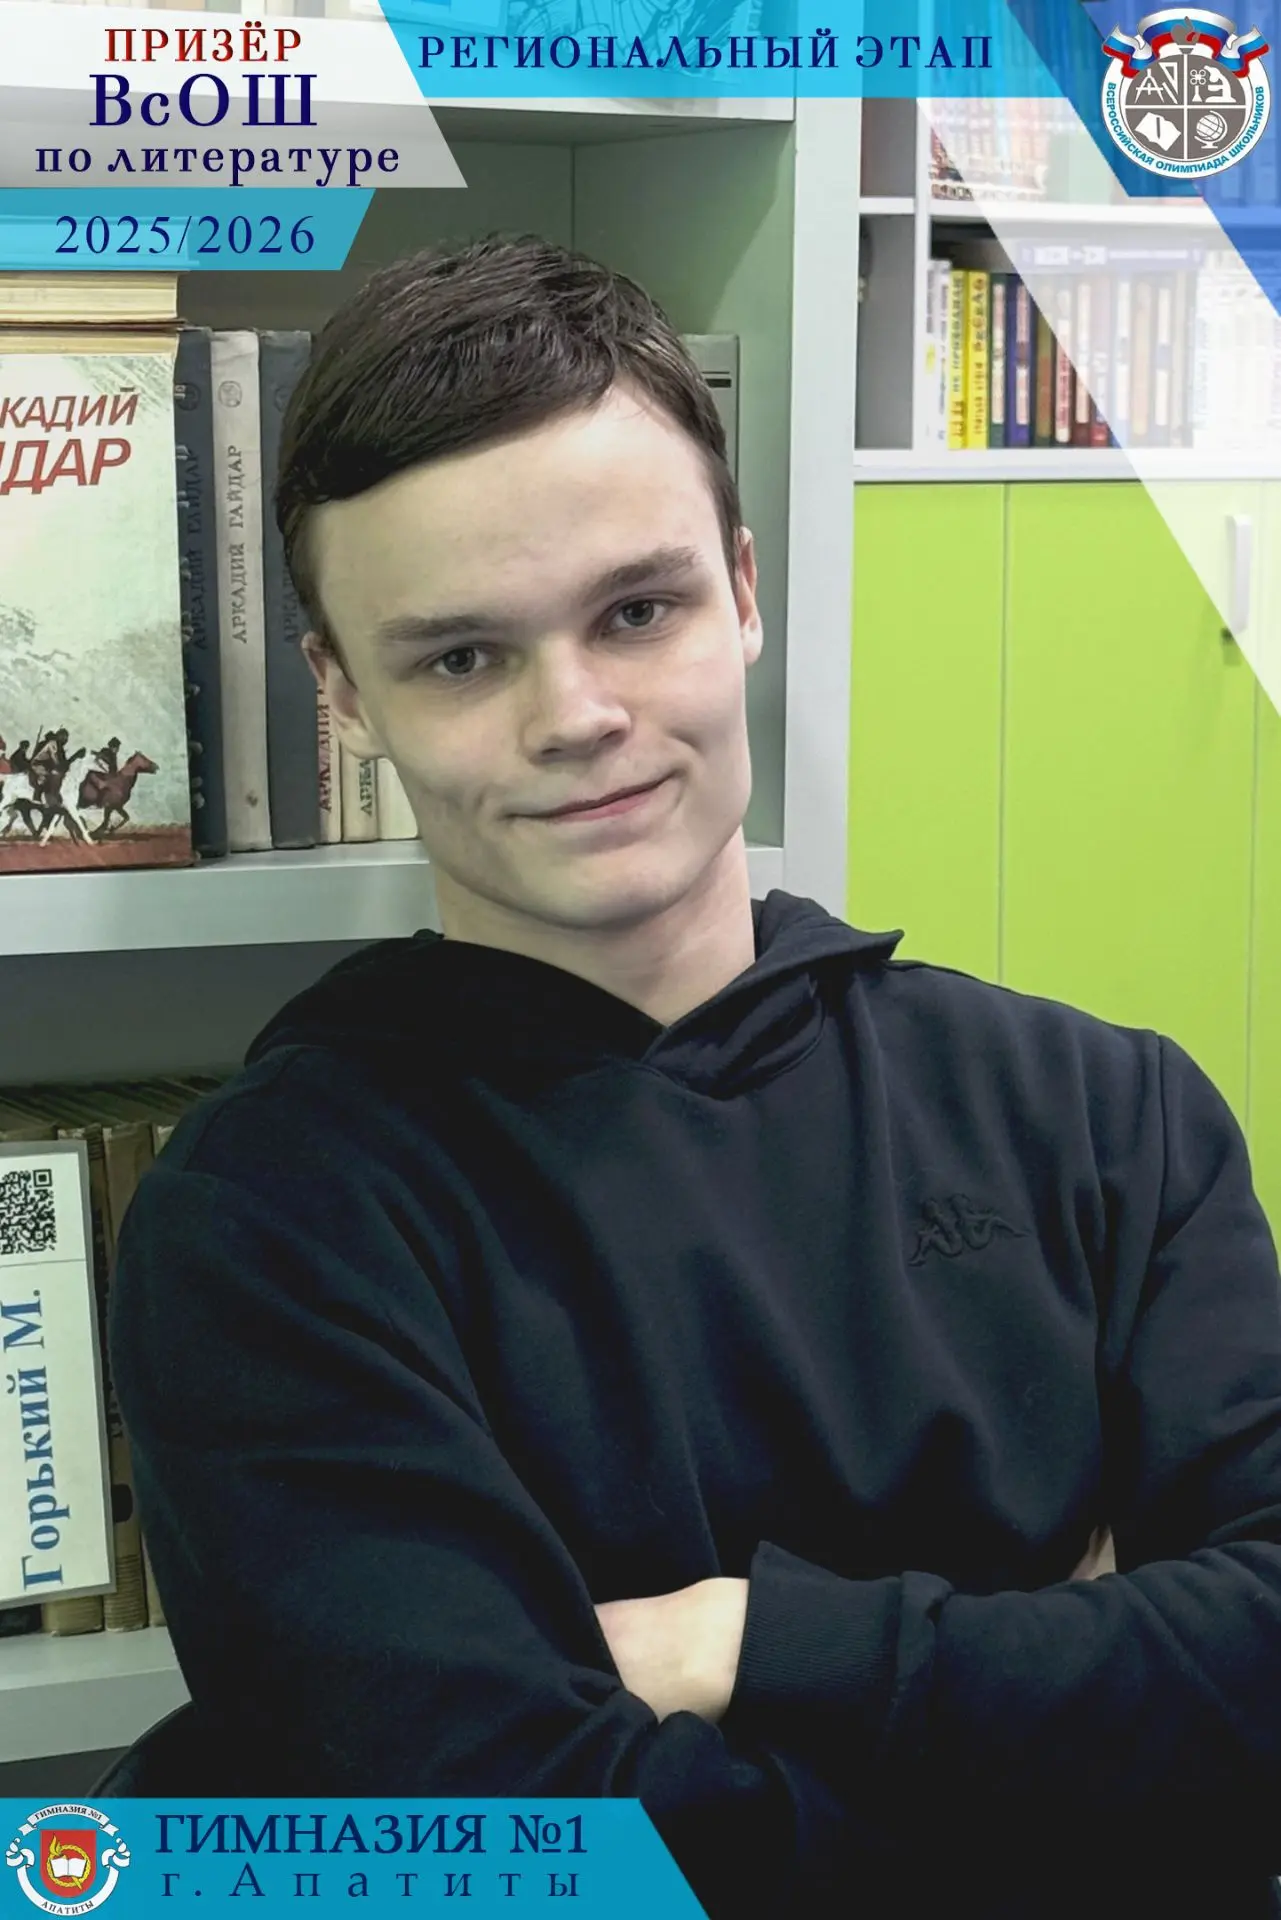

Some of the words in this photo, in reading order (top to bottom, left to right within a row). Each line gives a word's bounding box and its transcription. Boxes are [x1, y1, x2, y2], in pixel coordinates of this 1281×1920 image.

[0, 387, 139, 433] КАДИЙ
[227, 445, 245, 529] ГАЙДАР
[228, 543, 247, 644] АРКАДИЙ
[2, 1289, 45, 1351] М.
[6, 1367, 70, 1590] Горький
